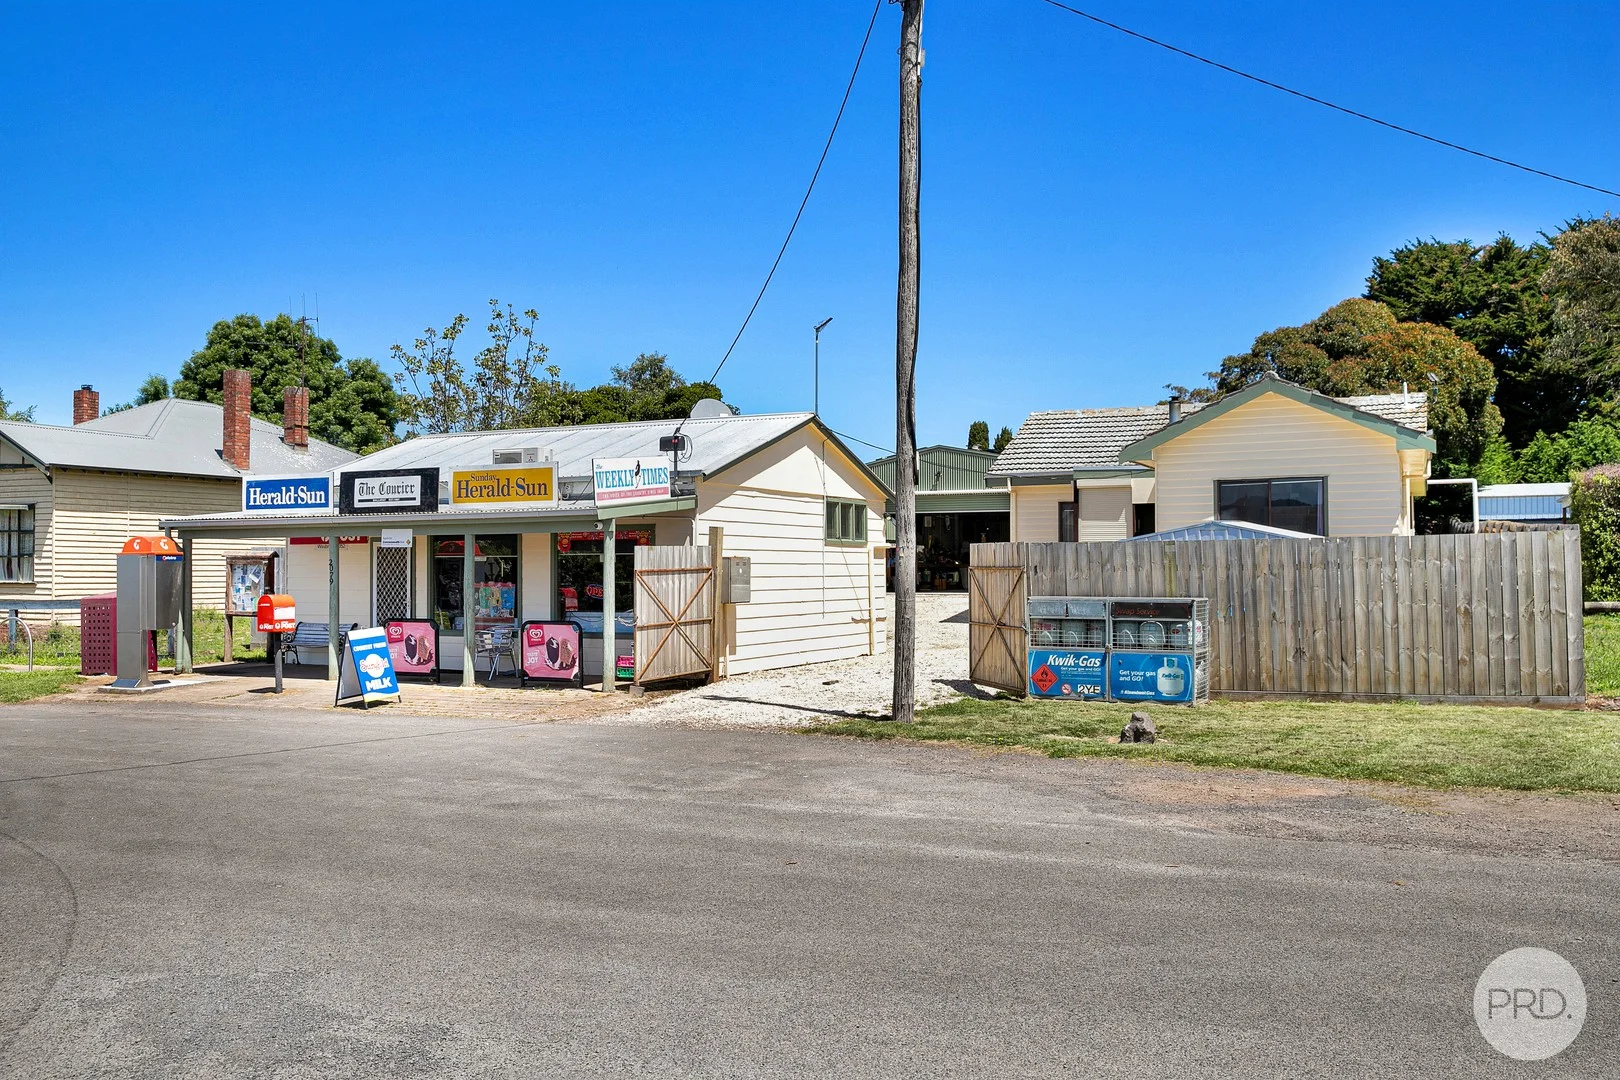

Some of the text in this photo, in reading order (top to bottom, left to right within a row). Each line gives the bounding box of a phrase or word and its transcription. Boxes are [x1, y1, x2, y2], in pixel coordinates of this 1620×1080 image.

[470, 473, 497, 483] Sunday
[595, 467, 668, 489] WEEKLY TIMES
[358, 481, 416, 497] The Courier
[456, 477, 549, 499] Herald-Sun
[248, 485, 326, 506] Herald-Sun
[1115, 607, 1161, 616] Swap Service
[280, 621, 296, 629] POST
[527, 656, 539, 664] JOY
[1047, 654, 1102, 667] Kwik-Gas
[1130, 669, 1145, 677] your
[365, 676, 393, 691] MILK
